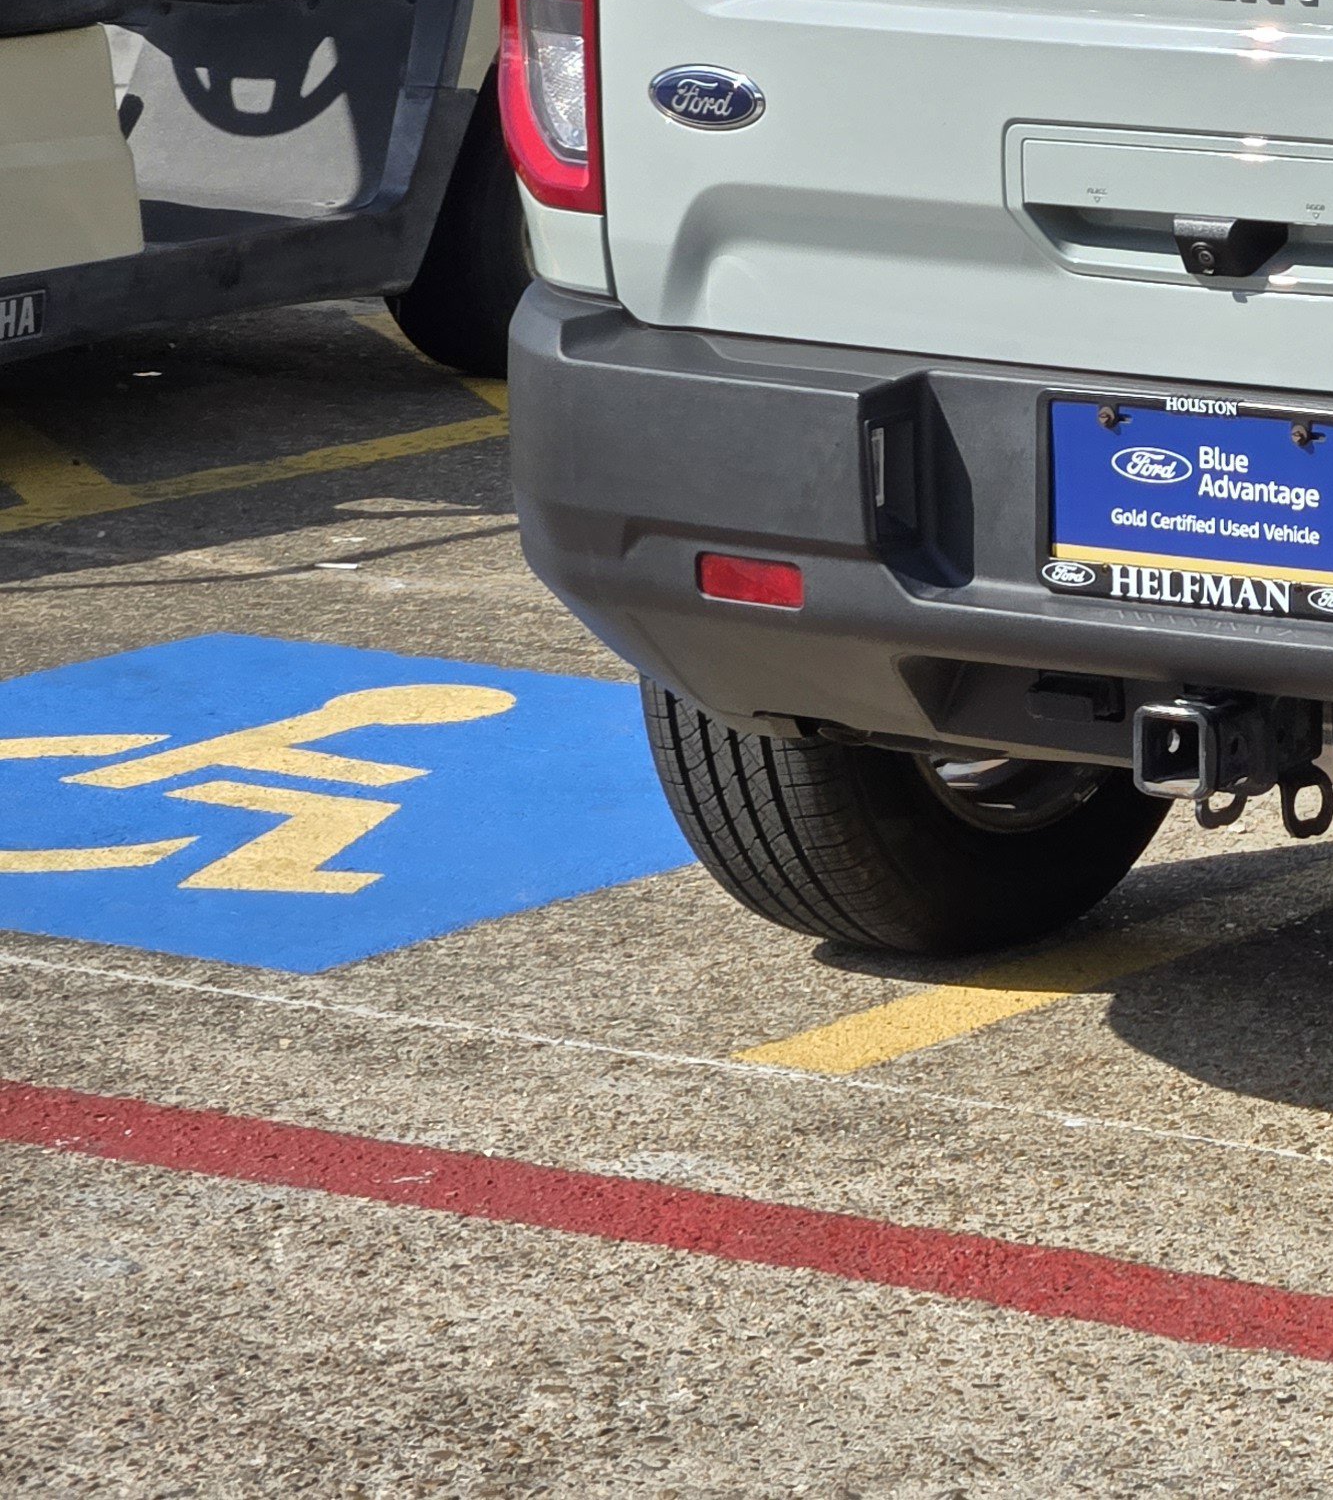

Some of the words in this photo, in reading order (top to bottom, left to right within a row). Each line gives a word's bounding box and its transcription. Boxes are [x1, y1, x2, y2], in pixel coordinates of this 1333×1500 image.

[670, 78, 734, 117] Ford
[1165, 396, 1238, 416] HOUSTON
[1126, 449, 1178, 481] Ford
[1199, 445, 1250, 473] Blue
[1198, 473, 1321, 511] Advantage
[1110, 507, 1148, 528] Gold
[1150, 511, 1217, 535] Certified
[1219, 519, 1260, 540] Used
[1263, 523, 1321, 545] Vehicle
[1051, 563, 1087, 585] Ford
[1109, 564, 1293, 615] HELFMAN
